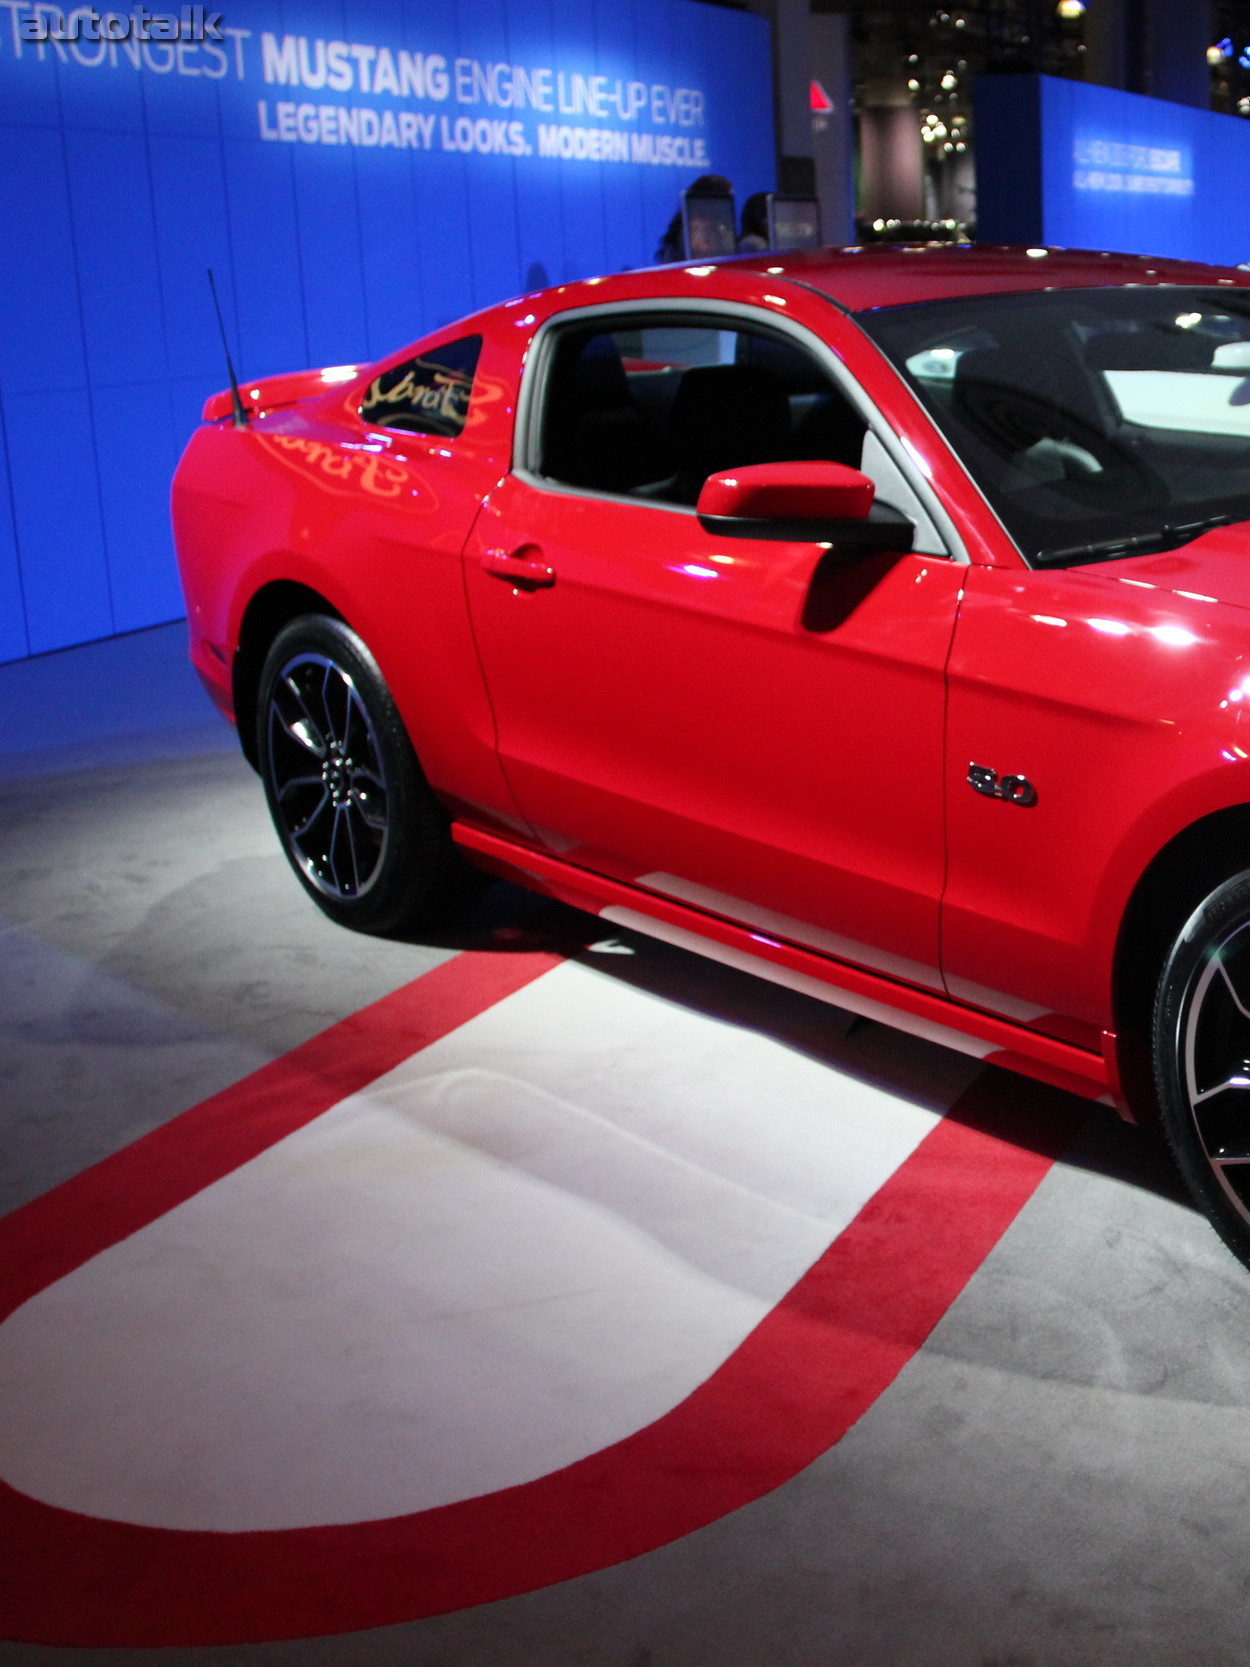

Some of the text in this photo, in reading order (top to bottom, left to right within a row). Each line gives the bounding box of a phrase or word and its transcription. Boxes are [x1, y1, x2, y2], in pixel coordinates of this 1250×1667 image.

[261, 31, 450, 101] MUSTANG
[454, 57, 555, 112] ENGINE
[557, 71, 648, 120] LINE-UP
[651, 85, 705, 126] EVER
[258, 100, 710, 167] LEGENDARY LOOKS. MODERN MUSCLE.
